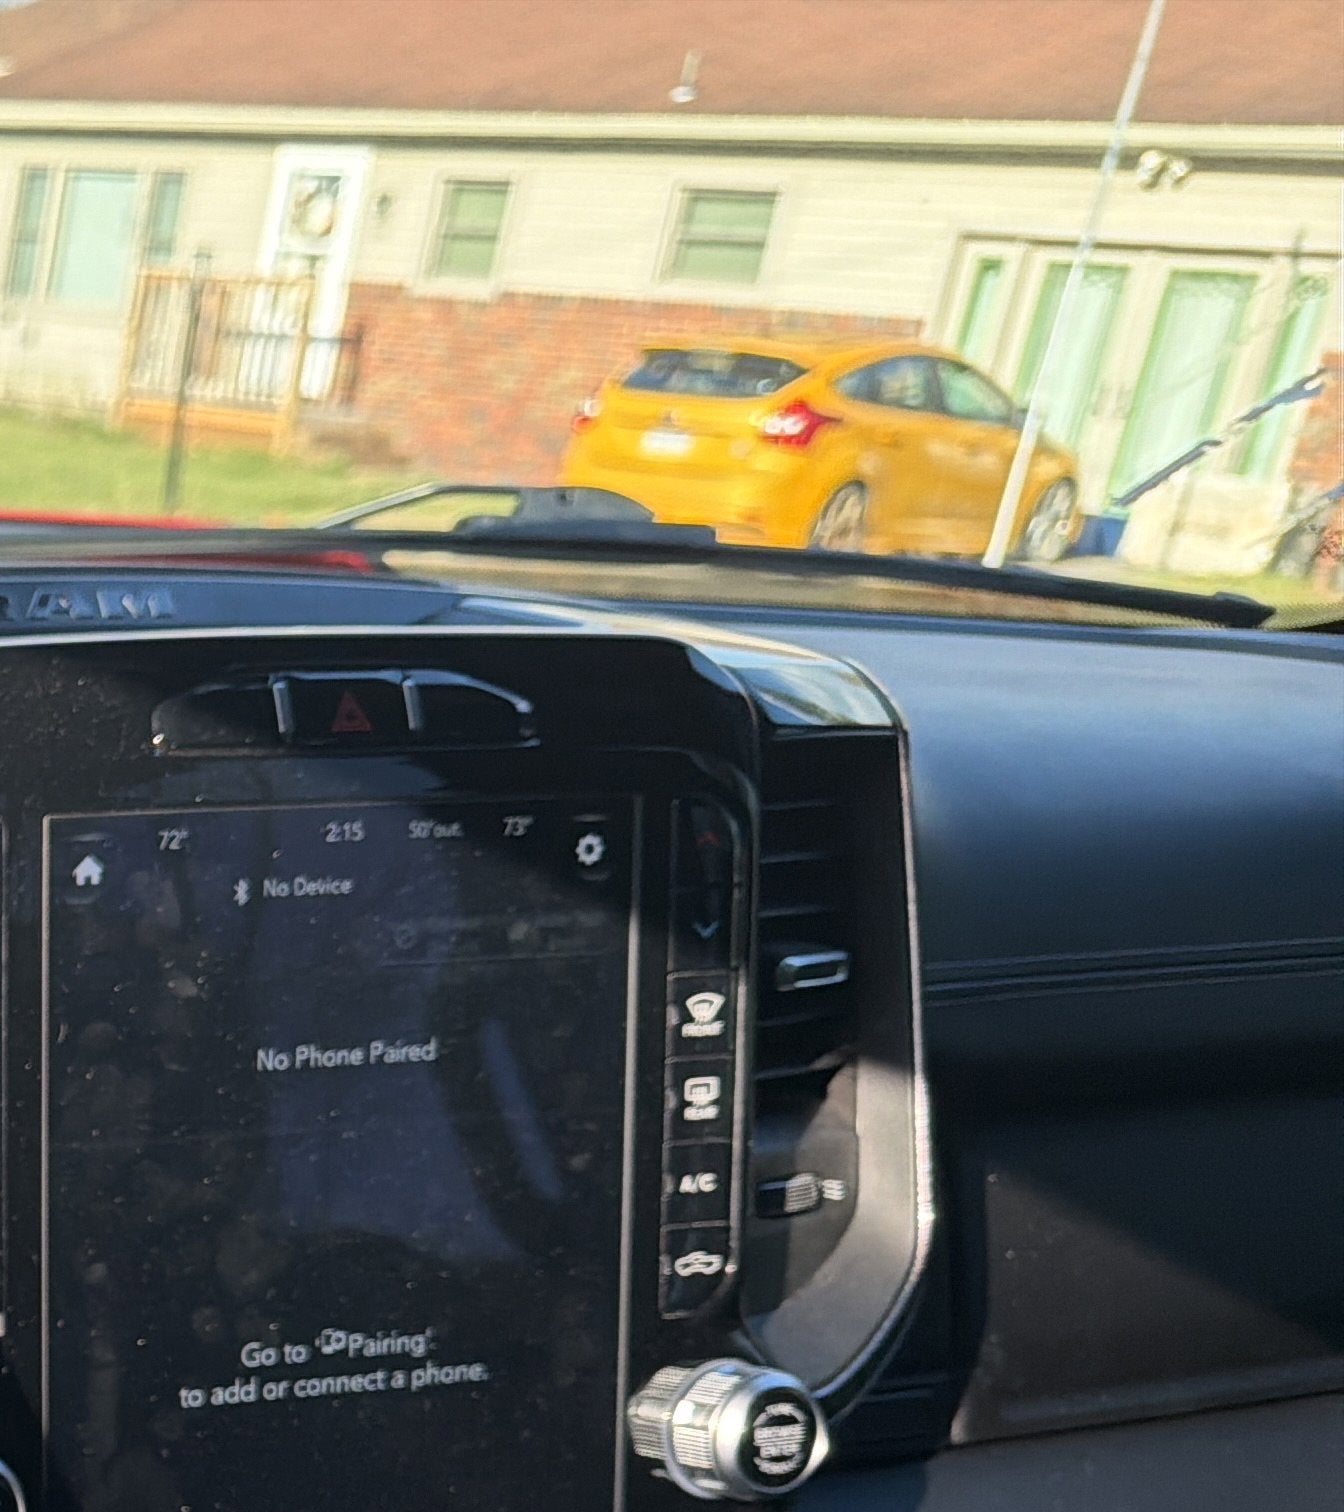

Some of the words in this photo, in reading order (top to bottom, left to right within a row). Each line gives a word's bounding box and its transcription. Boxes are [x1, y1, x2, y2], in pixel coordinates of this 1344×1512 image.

[324, 821, 365, 843] 2:15
[263, 878, 289, 897] No
[293, 876, 354, 896] Device
[256, 1049, 290, 1072] No
[294, 1044, 364, 1069] Phone
[369, 1036, 440, 1064] Paired
[679, 1172, 719, 1193] A/C
[241, 1342, 277, 1368] Go
[283, 1344, 310, 1364] to
[179, 1386, 205, 1408] to
[211, 1376, 257, 1405] add
[263, 1381, 289, 1400] or
[293, 1369, 388, 1398] connect
[390, 1370, 409, 1389] a
